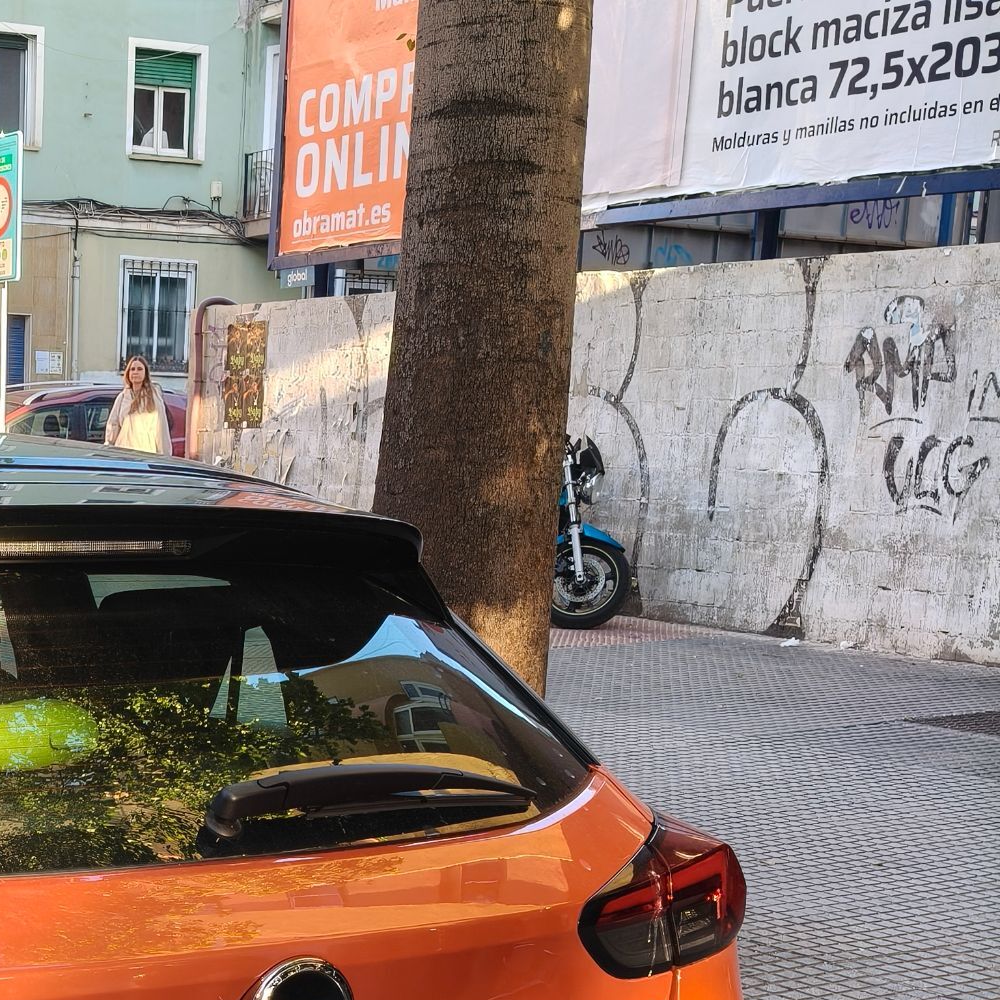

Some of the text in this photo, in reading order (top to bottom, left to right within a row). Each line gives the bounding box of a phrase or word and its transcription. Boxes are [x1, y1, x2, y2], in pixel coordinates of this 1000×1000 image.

[721, 16, 803, 68] block
[811, 0, 931, 50] maciza
[299, 62, 414, 136] COMPR
[717, 77, 818, 118] blanca
[712, 131, 779, 152] Molduras
[783, 129, 791, 146] y
[795, 116, 855, 140] manillas
[860, 115, 879, 130] no
[884, 101, 957, 126] incluidas
[963, 99, 984, 115] en
[295, 121, 409, 198] ONLIN
[293, 202, 391, 237] obramat.es
[287, 270, 307, 286] global
